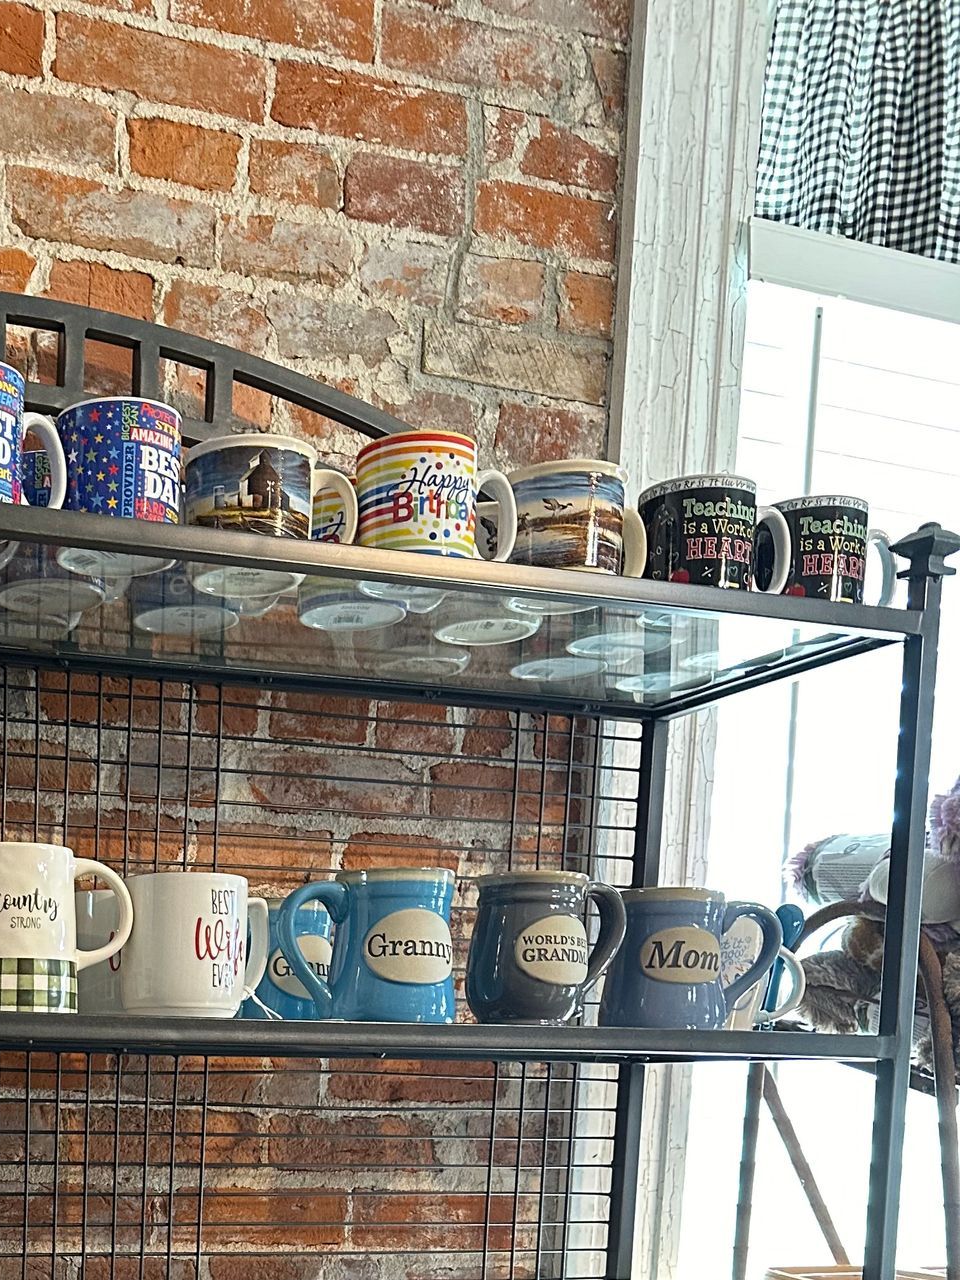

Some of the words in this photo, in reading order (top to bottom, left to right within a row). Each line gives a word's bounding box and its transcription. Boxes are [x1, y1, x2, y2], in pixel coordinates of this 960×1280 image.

[131, 427, 173, 450] AMAZING
[124, 444, 135, 517] PROVIDER
[388, 465, 470, 503] Happy
[135, 498, 166, 515] HARD
[683, 498, 756, 523] Teaching
[683, 521, 696, 534] is
[712, 519, 746, 536] Work
[686, 537, 752, 564] HEART
[800, 538, 812, 551] is
[828, 536, 860, 552] Work
[211, 889, 237, 915] BEST
[10, 917, 42, 929] STRONG
[367, 932, 452, 965] Granny
[522, 935, 575, 946] WORLD'S
[645, 940, 720, 972] Mom
